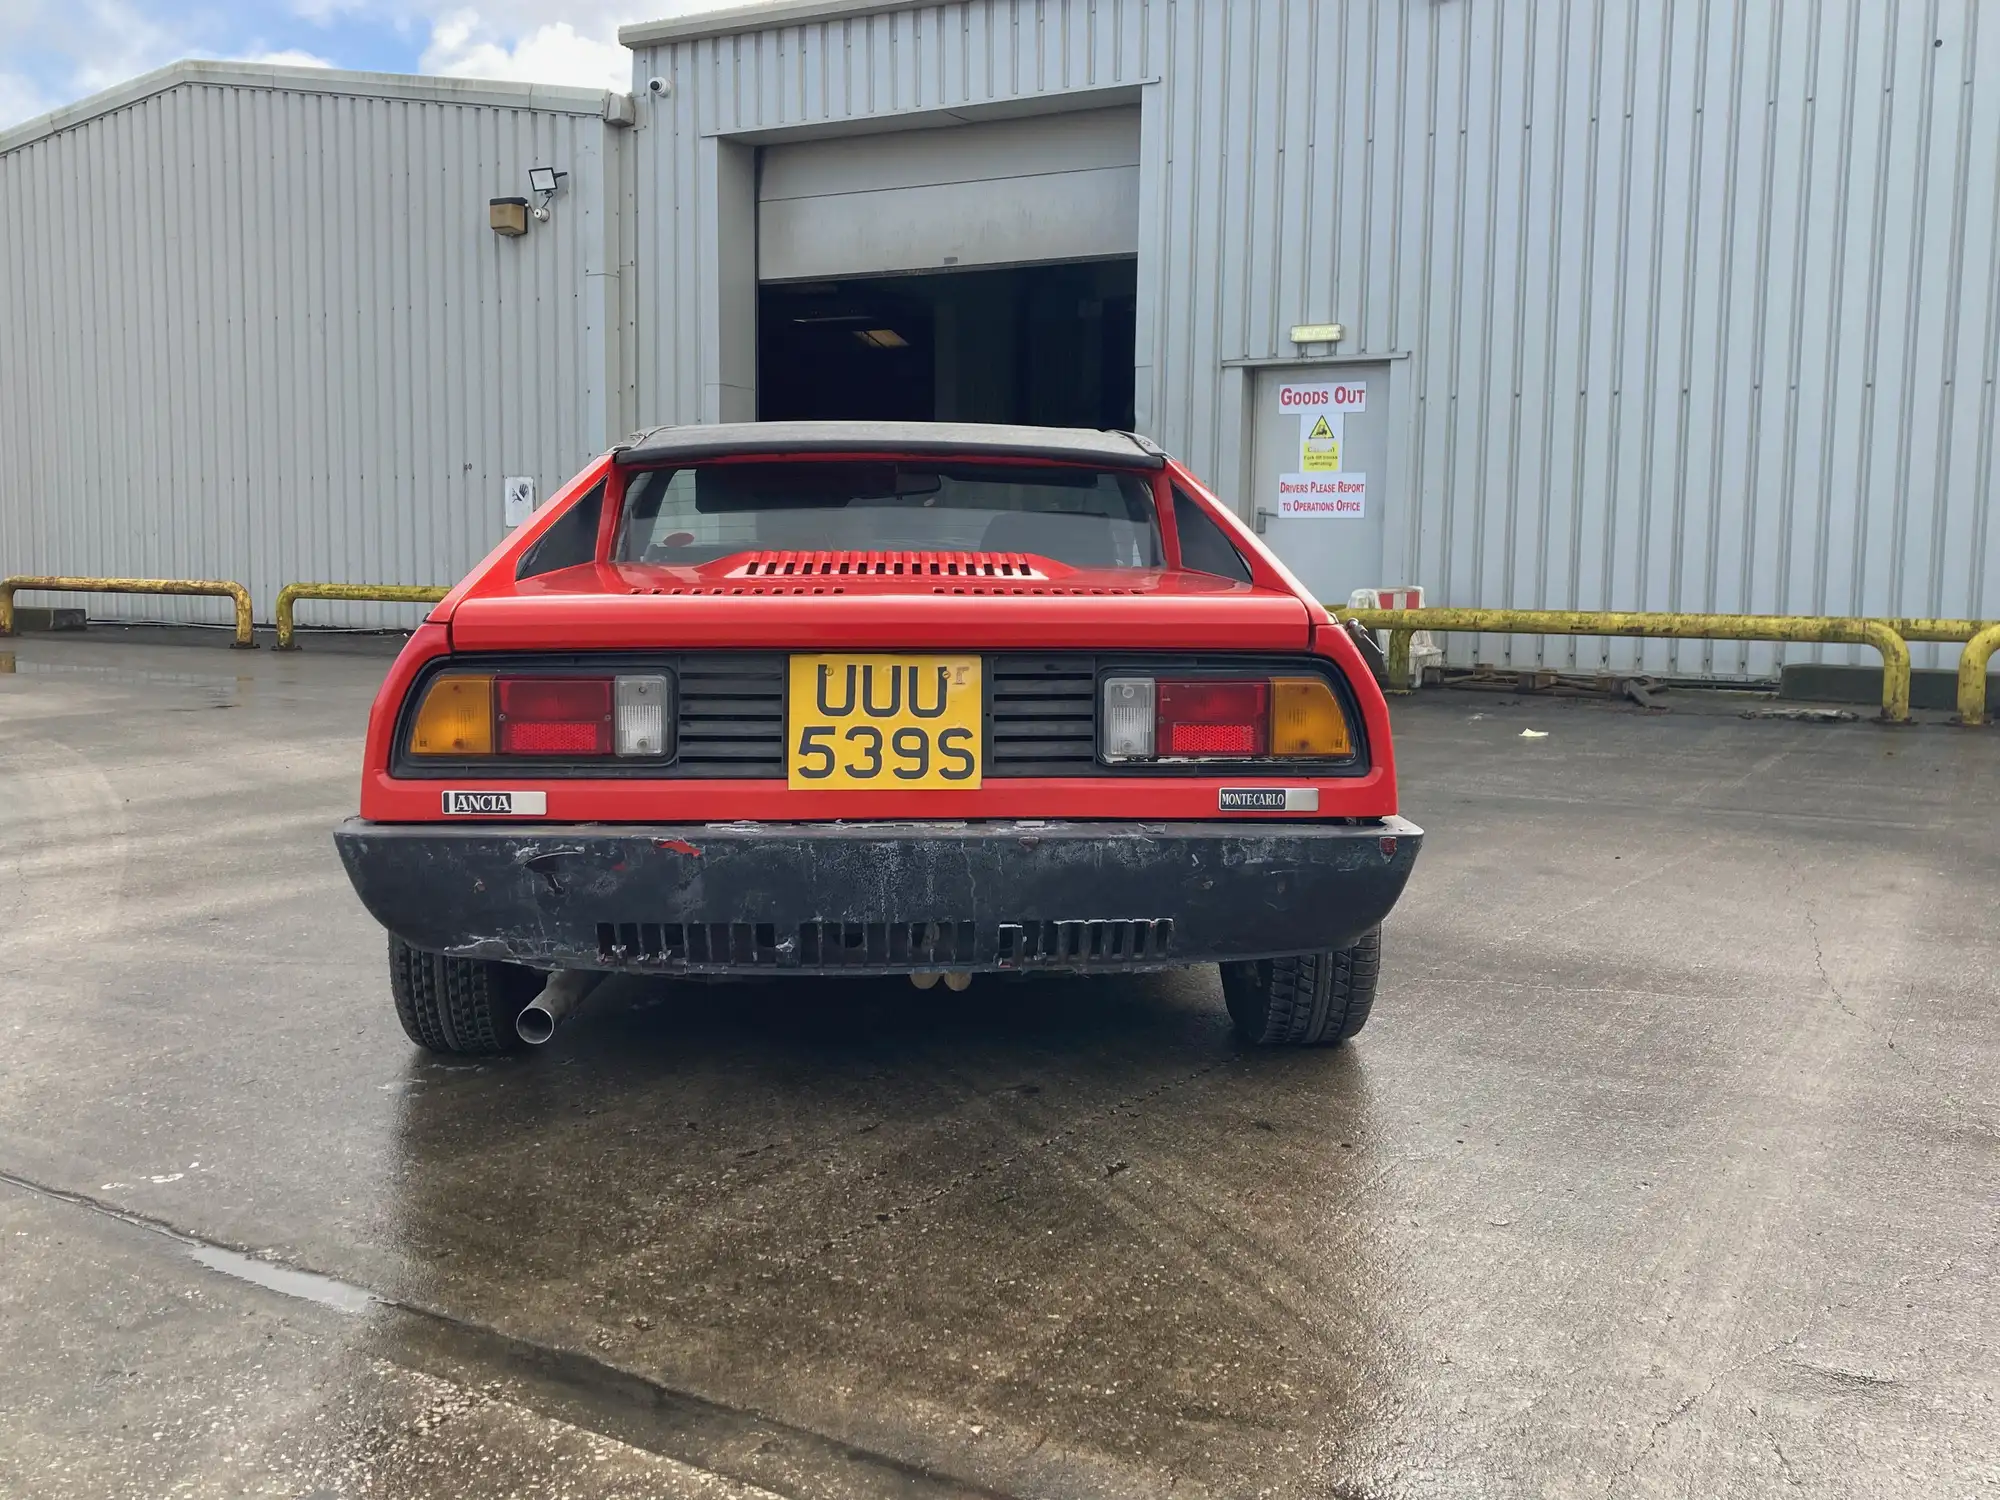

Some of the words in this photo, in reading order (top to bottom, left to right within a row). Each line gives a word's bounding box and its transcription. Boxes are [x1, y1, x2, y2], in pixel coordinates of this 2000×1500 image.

[817, 664, 948, 718] UUU
[798, 725, 975, 780] 539S
[449, 792, 512, 814] LANCIA
[1222, 793, 1285, 806] MONTECARLO
